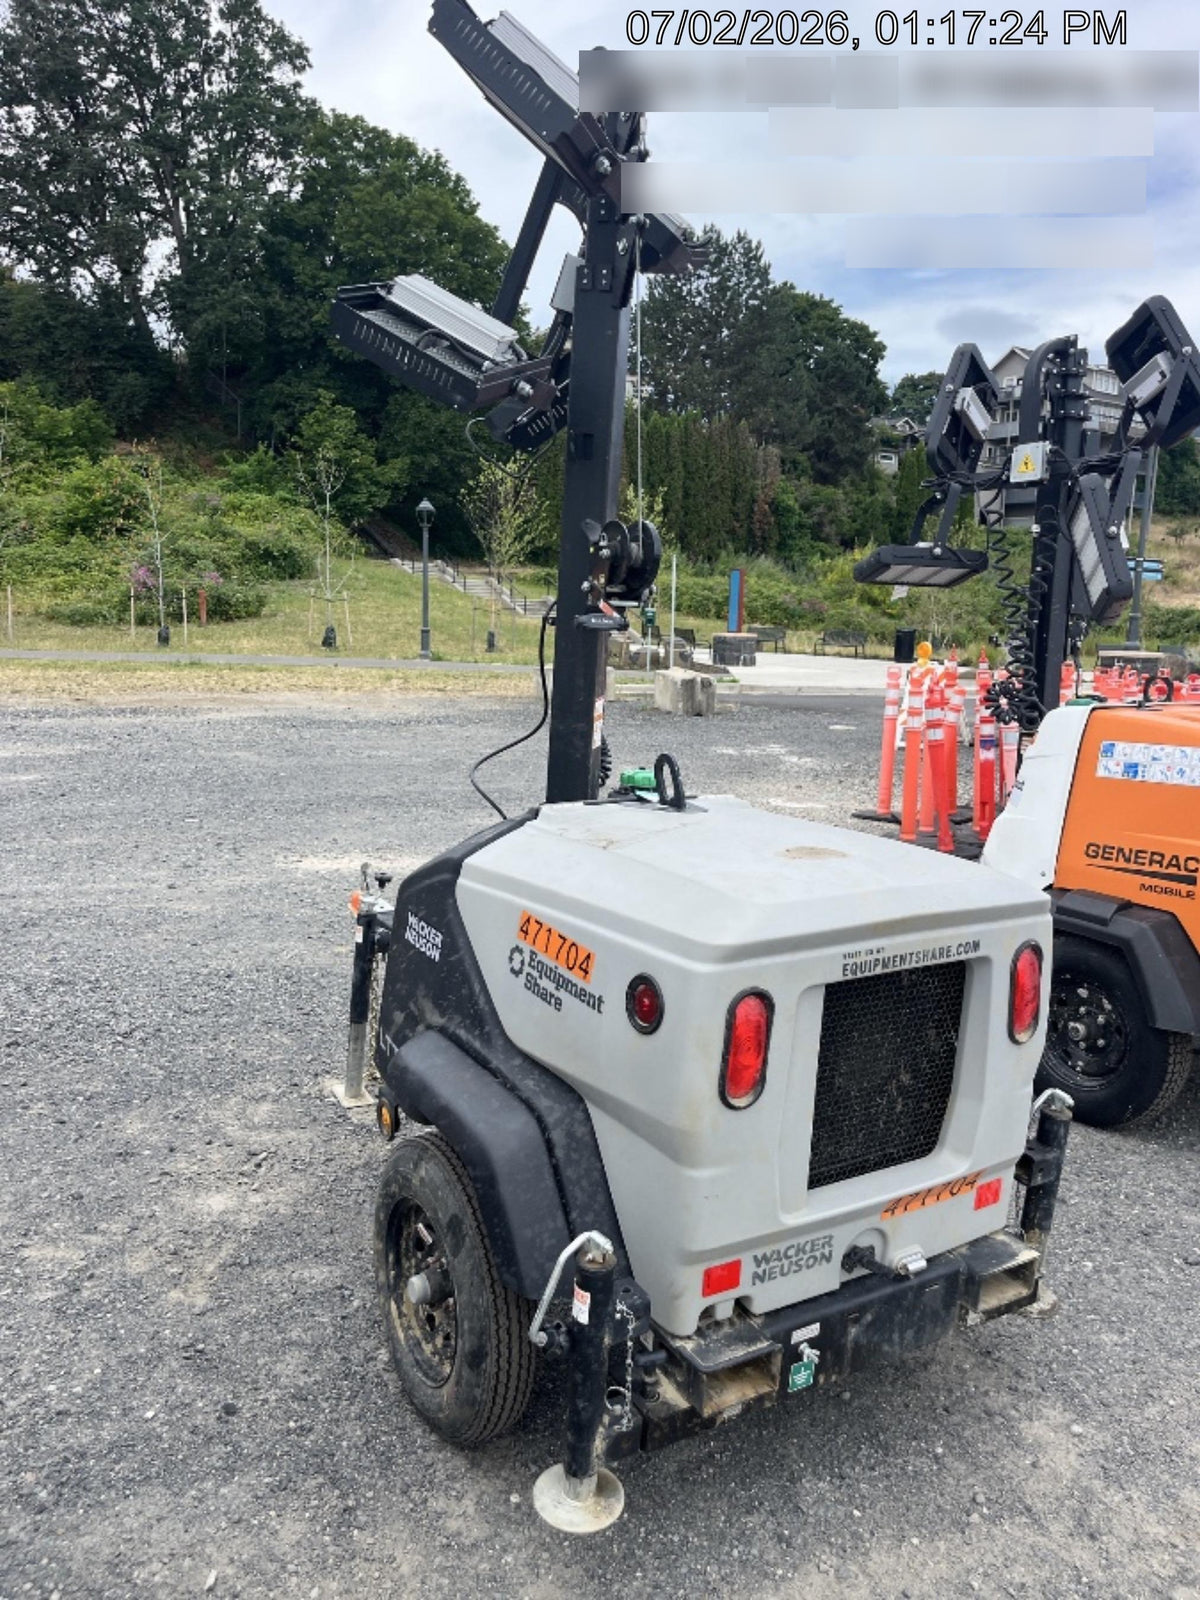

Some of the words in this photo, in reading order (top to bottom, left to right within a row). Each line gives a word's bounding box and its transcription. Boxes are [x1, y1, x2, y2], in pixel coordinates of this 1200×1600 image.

[1085, 842, 1200, 874] GENERAC
[1139, 883, 1196, 901] MOBILE
[405, 926, 441, 962] NEUSON
[408, 911, 443, 948] WACKER
[520, 915, 591, 980] 471704
[842, 939, 981, 977] EQUIPMENTSHARE.COM
[524, 971, 563, 1012] Share
[528, 949, 605, 1014] Equipment
[751, 1250, 834, 1286] NEUSON
[752, 1234, 835, 1269] WACKER
